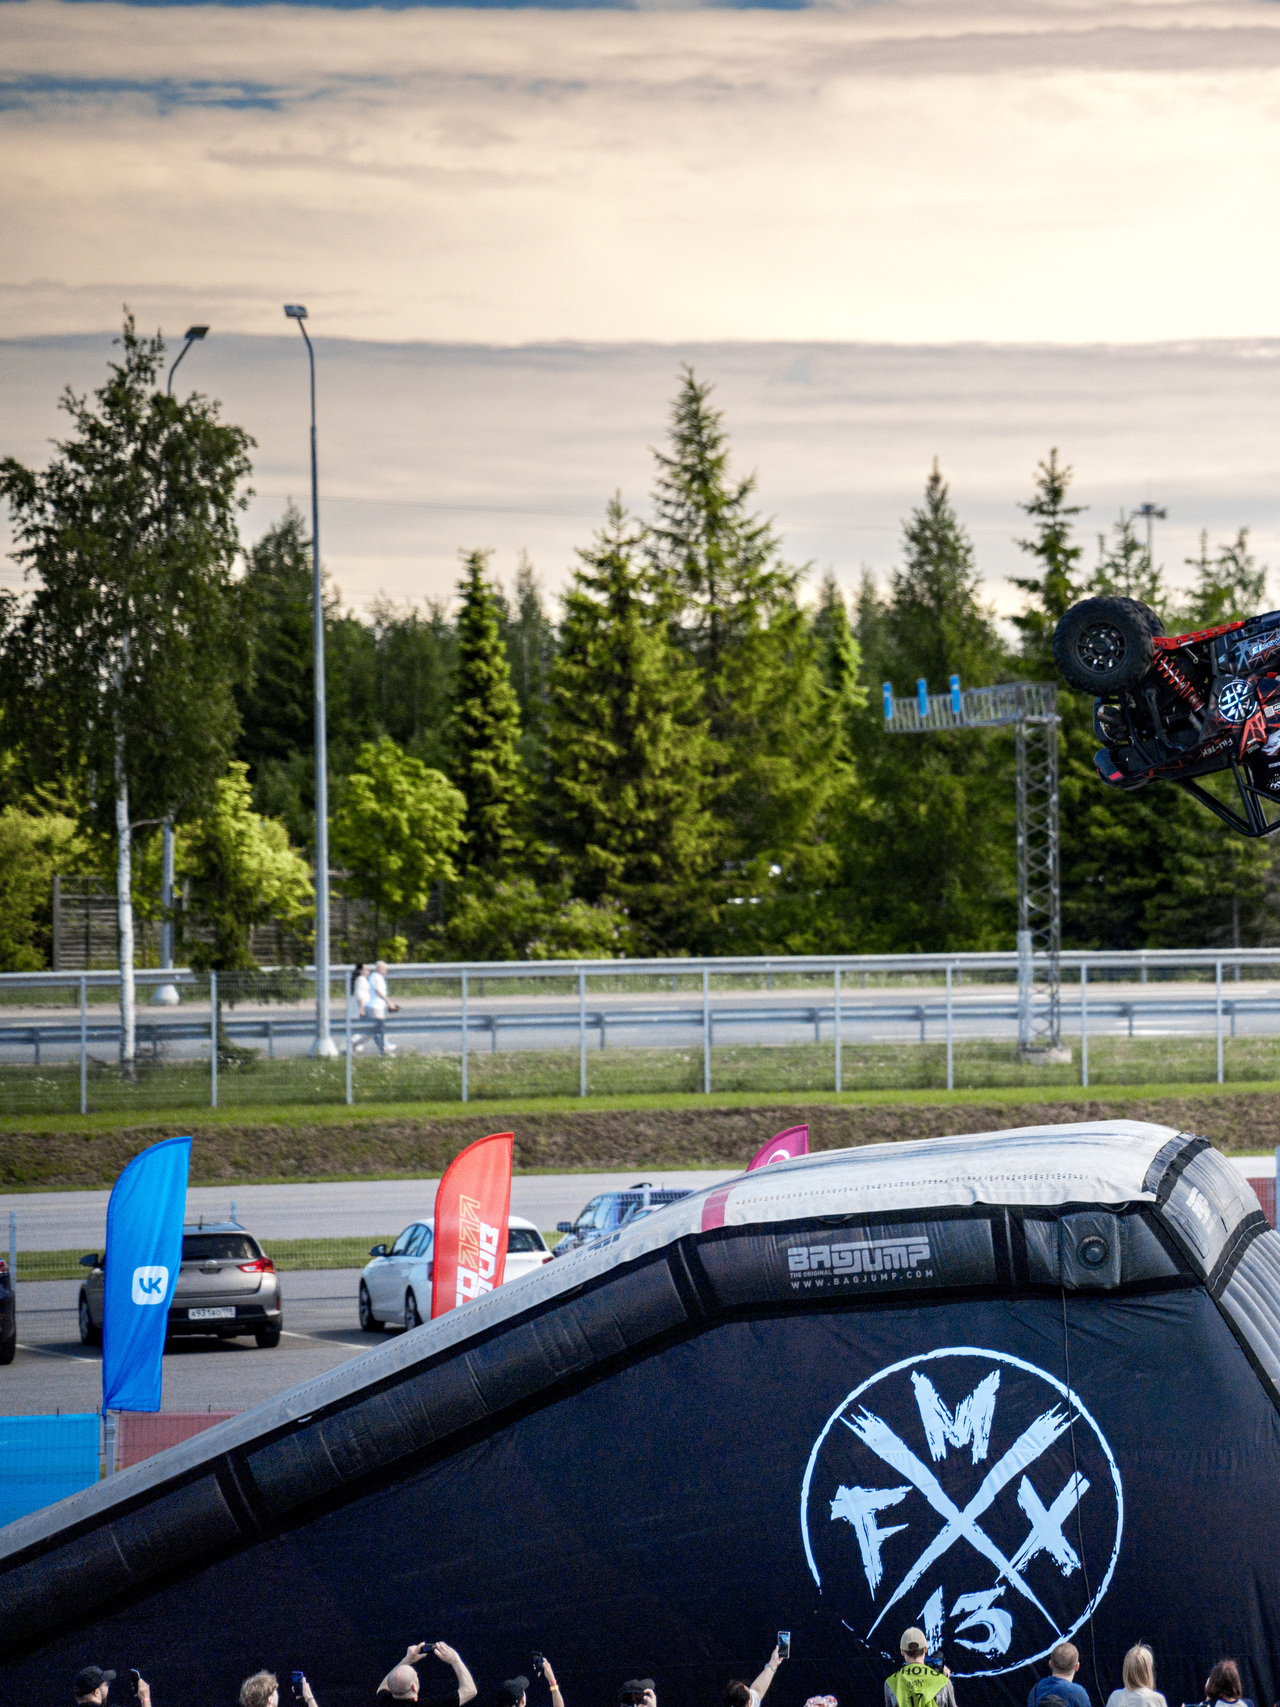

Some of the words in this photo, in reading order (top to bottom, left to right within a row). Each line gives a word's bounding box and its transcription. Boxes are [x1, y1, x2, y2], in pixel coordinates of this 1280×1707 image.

[788, 1236, 931, 1275] BAGJUMP
[789, 1271, 802, 1279] THE
[802, 1269, 833, 1277] ORIGINAL
[790, 1269, 933, 1290] WWW.BAGJUMP.COM
[139, 1277, 162, 1294] VK
[894, 1666, 940, 1678] HOTO
